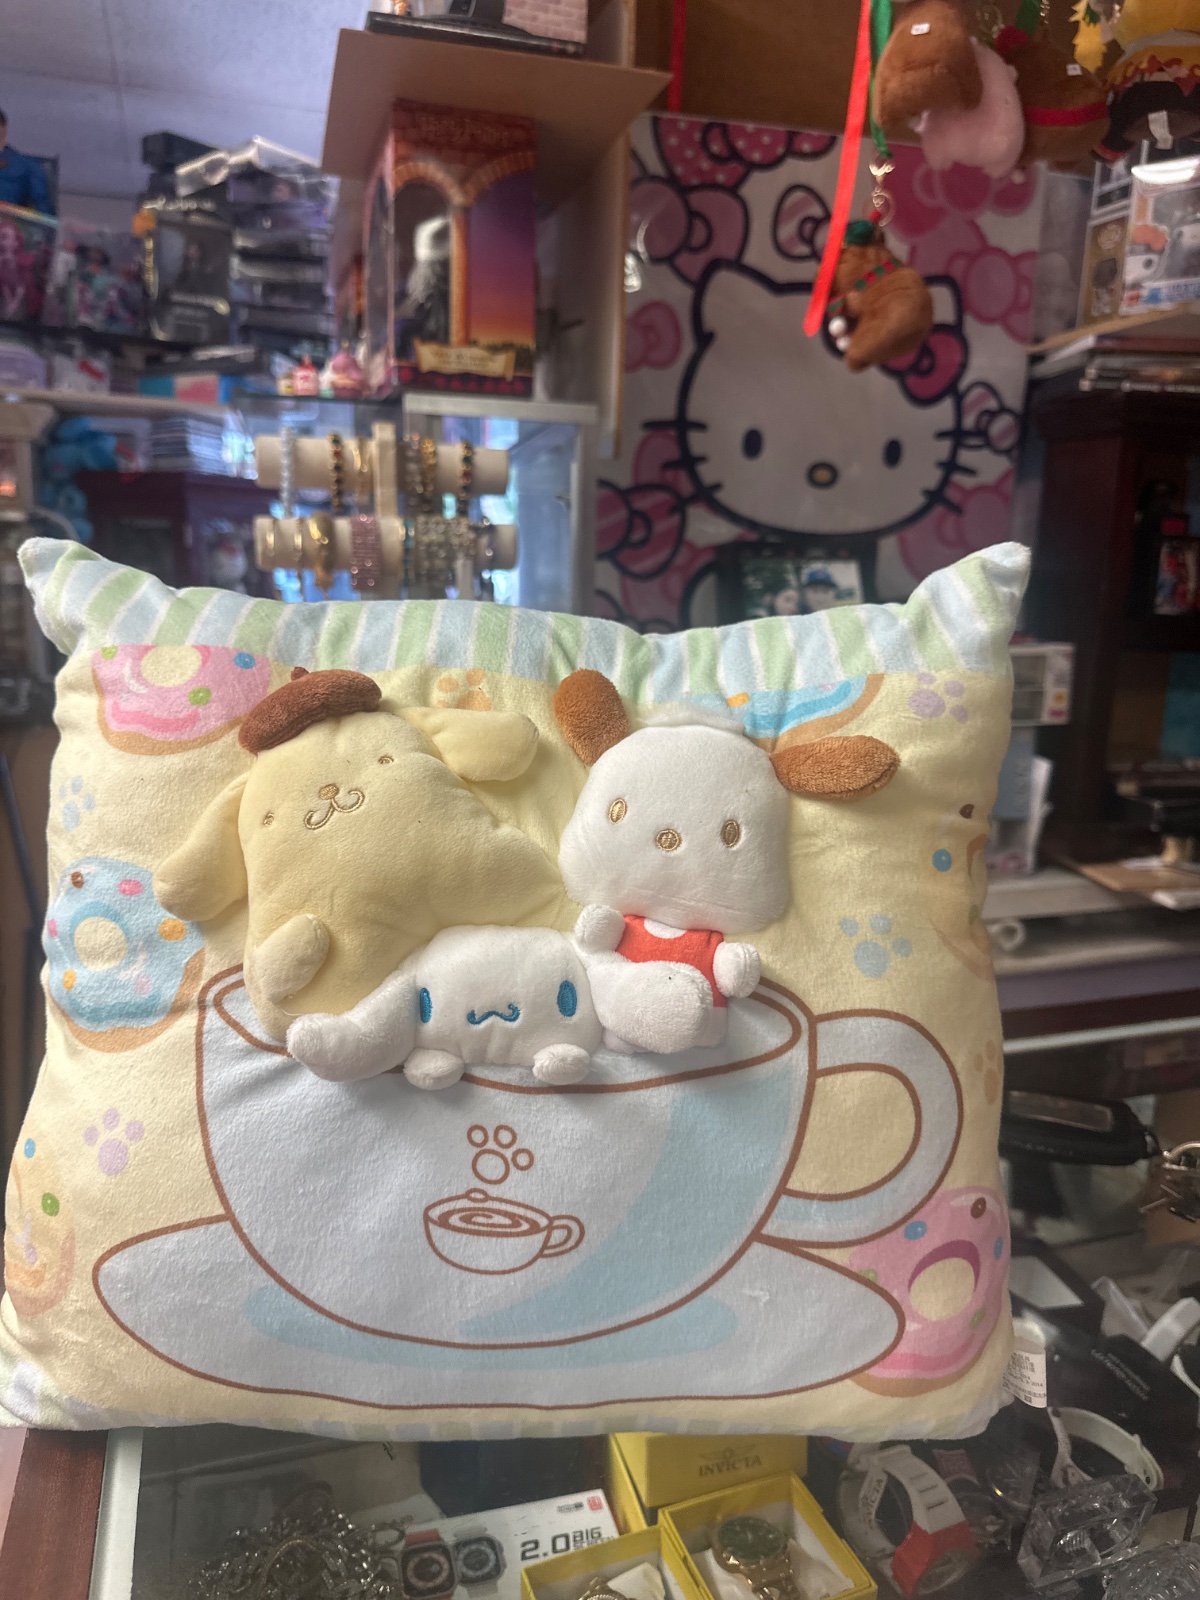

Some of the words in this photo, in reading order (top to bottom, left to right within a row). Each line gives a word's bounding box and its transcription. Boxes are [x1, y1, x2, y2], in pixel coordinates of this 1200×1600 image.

[698, 1454, 762, 1477] INVICTA
[520, 1532, 570, 1562] 2.0
[572, 1526, 602, 1543] BIG
